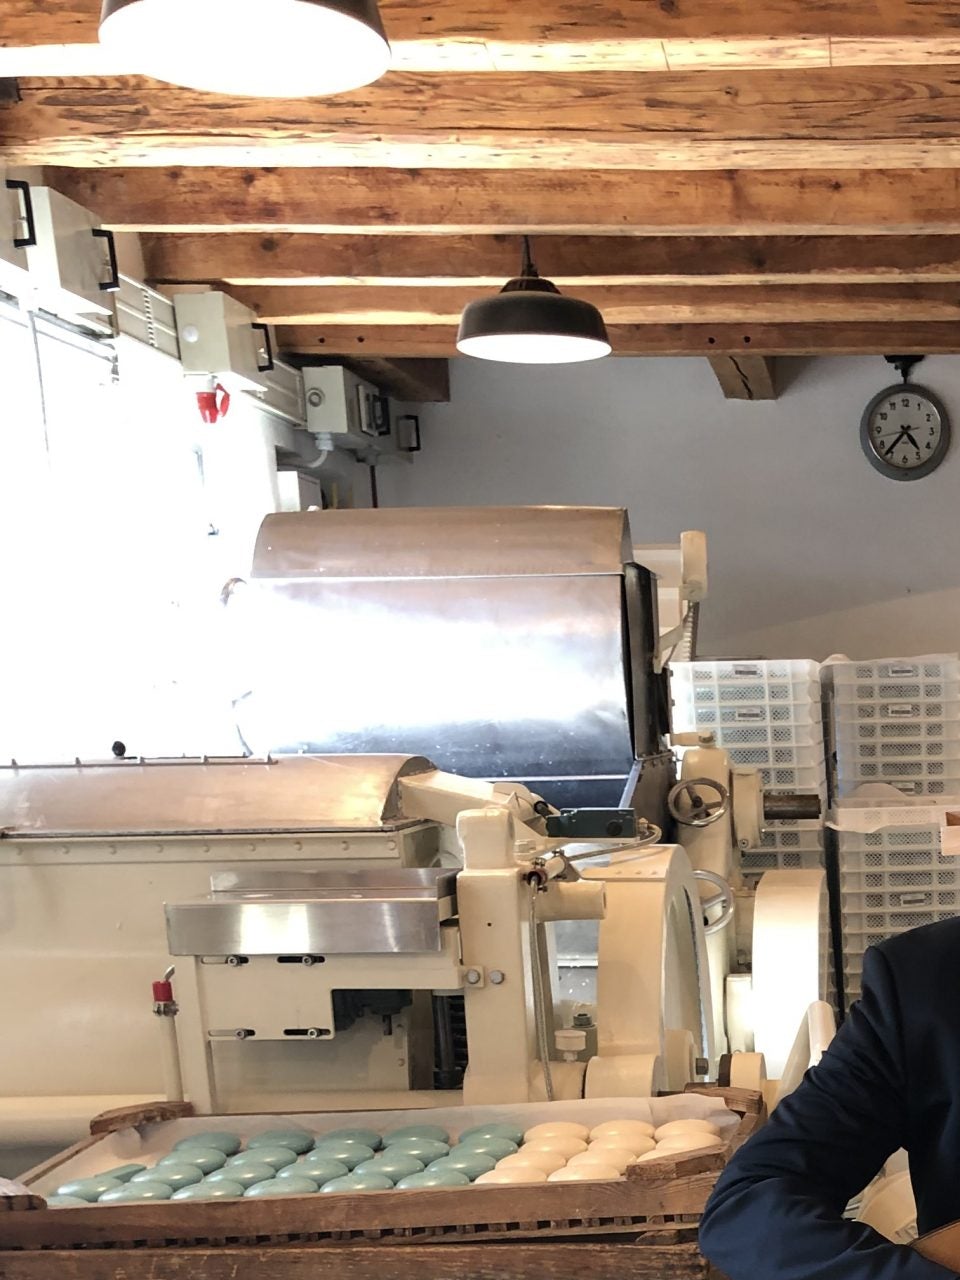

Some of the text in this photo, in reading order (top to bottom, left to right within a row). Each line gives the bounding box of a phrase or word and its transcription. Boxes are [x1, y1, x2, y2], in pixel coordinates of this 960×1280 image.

[889, 402, 896, 410] 11
[901, 399, 909, 408] 12
[880, 412, 888, 420] 10
[926, 413, 931, 422] 2
[876, 426, 882, 434] 9
[929, 427, 934, 436] 3
[880, 440, 885, 449] 8
[902, 455, 908, 464] 6
[915, 451, 920, 460] 5
